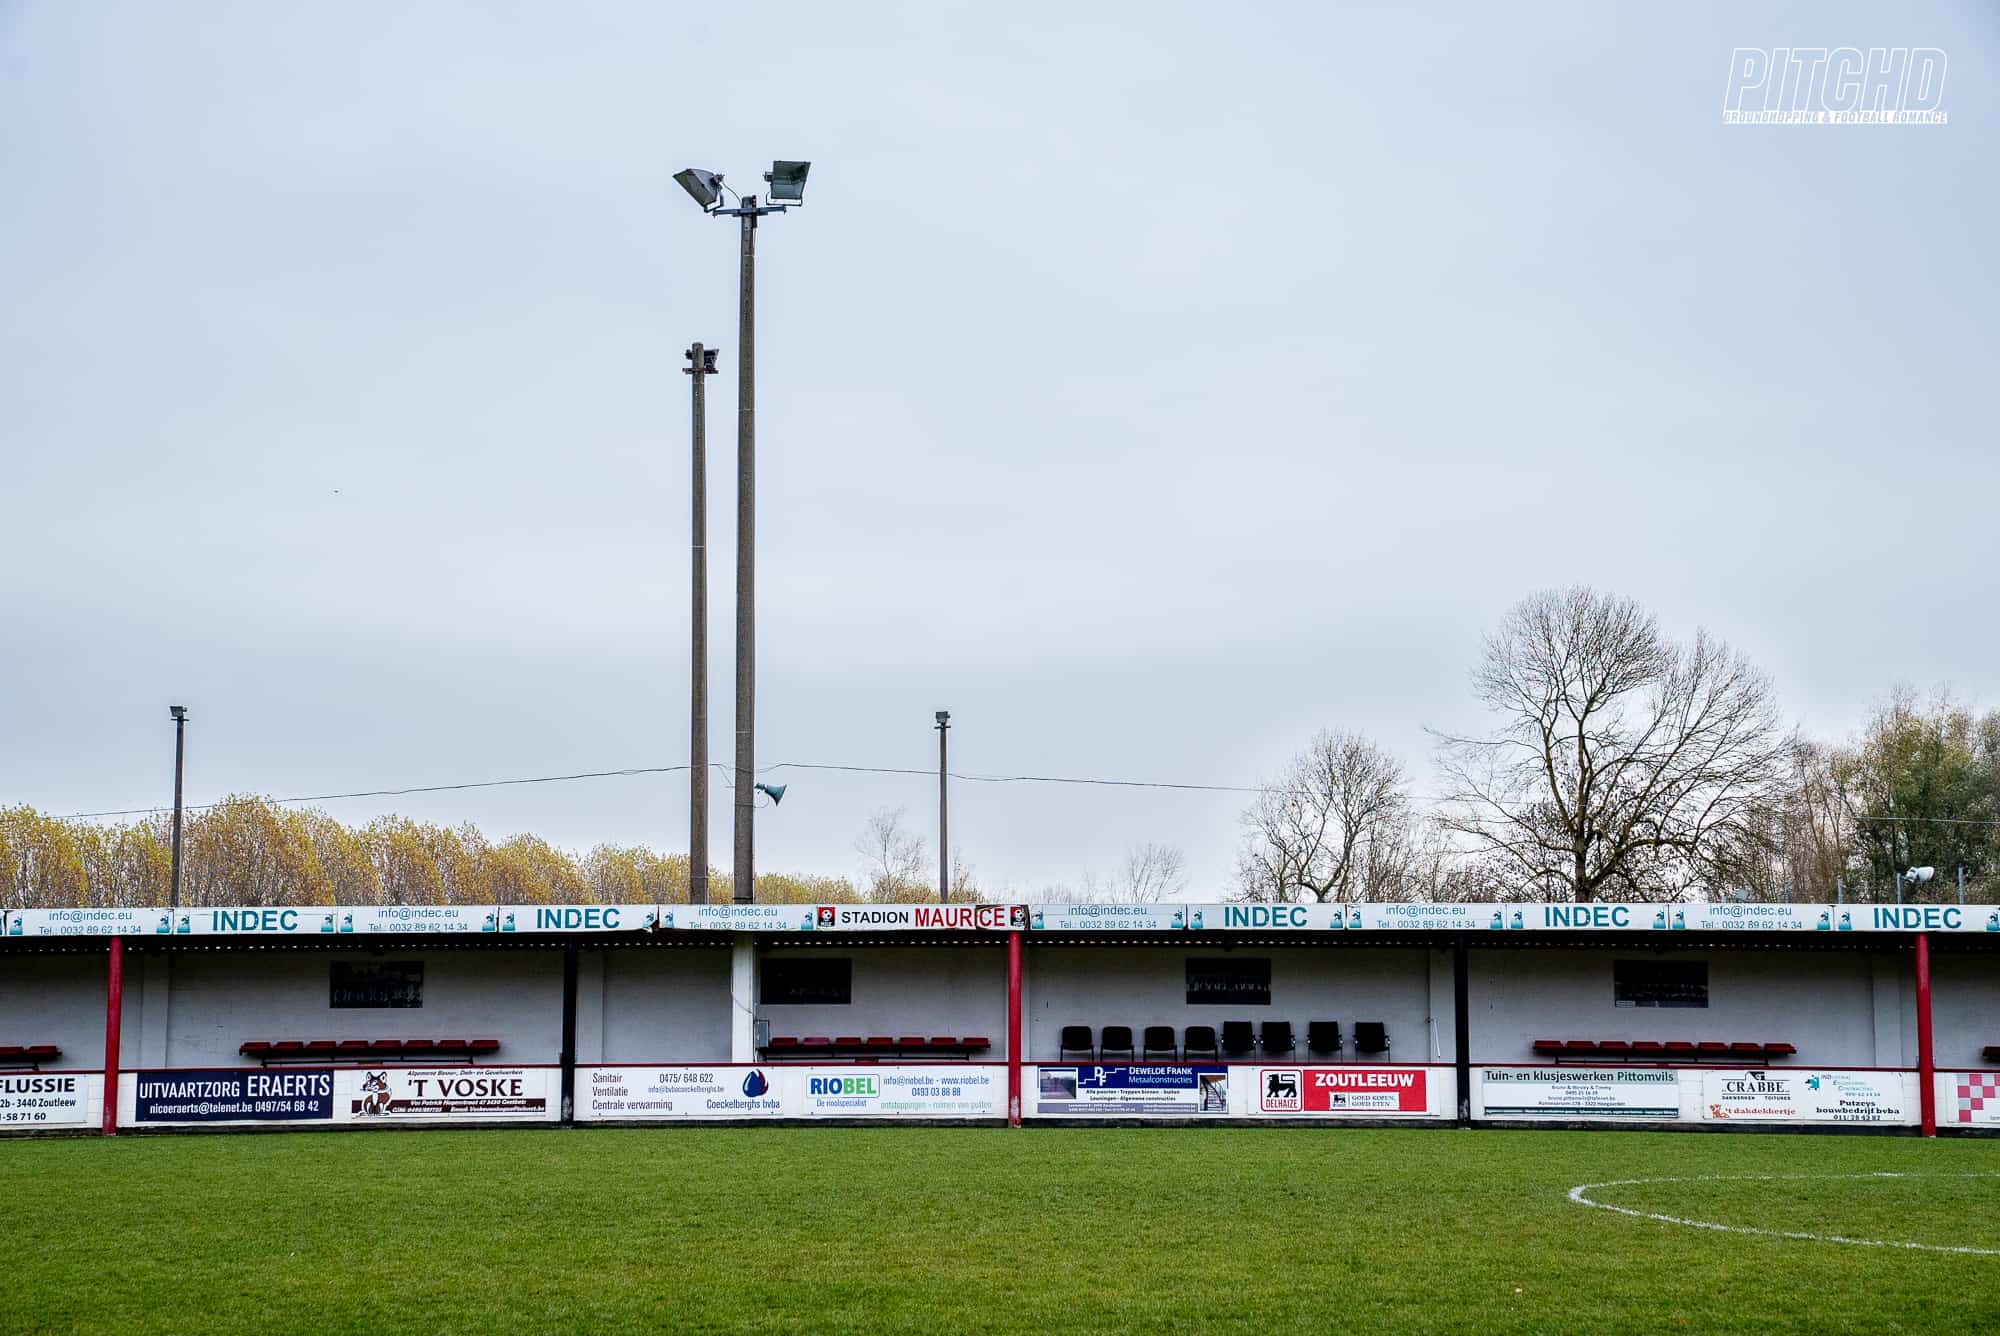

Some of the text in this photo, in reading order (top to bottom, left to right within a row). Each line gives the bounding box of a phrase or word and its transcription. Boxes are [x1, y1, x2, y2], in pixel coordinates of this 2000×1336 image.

[49, 910, 132, 922] info@indec.eu
[378, 908, 459, 920] info@indec.eu
[699, 905, 778, 918] info@indec.eu
[1068, 904, 1147, 917] info@indec.eu
[1225, 906, 1308, 927] INDEC
[1386, 905, 1466, 917] info@indec.eu
[1710, 905, 1792, 917] info@indec.eu
[212, 910, 298, 931] INDEC
[537, 908, 620, 929] INDEC
[842, 908, 1005, 927] STADION MAURICE
[1545, 907, 1630, 927] INDEC
[1874, 908, 1962, 928] INDEC
[61, 926, 82, 934] 0032
[87, 926, 98, 934] 89
[102, 926, 112, 934] 62
[1119, 920, 1130, 928] 62
[1133, 920, 1143, 928] 14
[1146, 920, 1157, 928] 34
[1437, 920, 1448, 928] 62
[1452, 920, 1461, 928] 14
[1465, 920, 1476, 928] 34
[1762, 921, 1773, 929] 62
[1778, 921, 1787, 929] 14
[1791, 921, 1802, 929] 34
[592, 1073, 622, 1084] Sanitair
[660, 1073, 682, 1083] 0475/
[700, 1073, 713, 1082] 622
[884, 1076, 934, 1085] info@riobel.be
[942, 1076, 989, 1085] www.riobel.be
[1315, 1074, 1414, 1086] ZOUTLEEUW
[1486, 1071, 1674, 1082] Tuin- en klusjeswerken Pittomvils
[139, 1075, 330, 1098] UITVAARTZORG ERAERTS
[408, 1079, 523, 1097] 'T VOSKE
[592, 1086, 628, 1096] Ventilatie
[810, 1078, 877, 1094] RIOBEL
[1727, 1081, 1784, 1092] CRABBE
[17, 1099, 37, 1107] 3440
[150, 1101, 319, 1114] nicoeraerts@telenet.be 0497/54 68 42
[592, 1099, 673, 1111] Centrale verwarming
[706, 1099, 780, 1110] Coeckelberghs bvba
[1266, 1099, 1297, 1108] DELHAIZE
